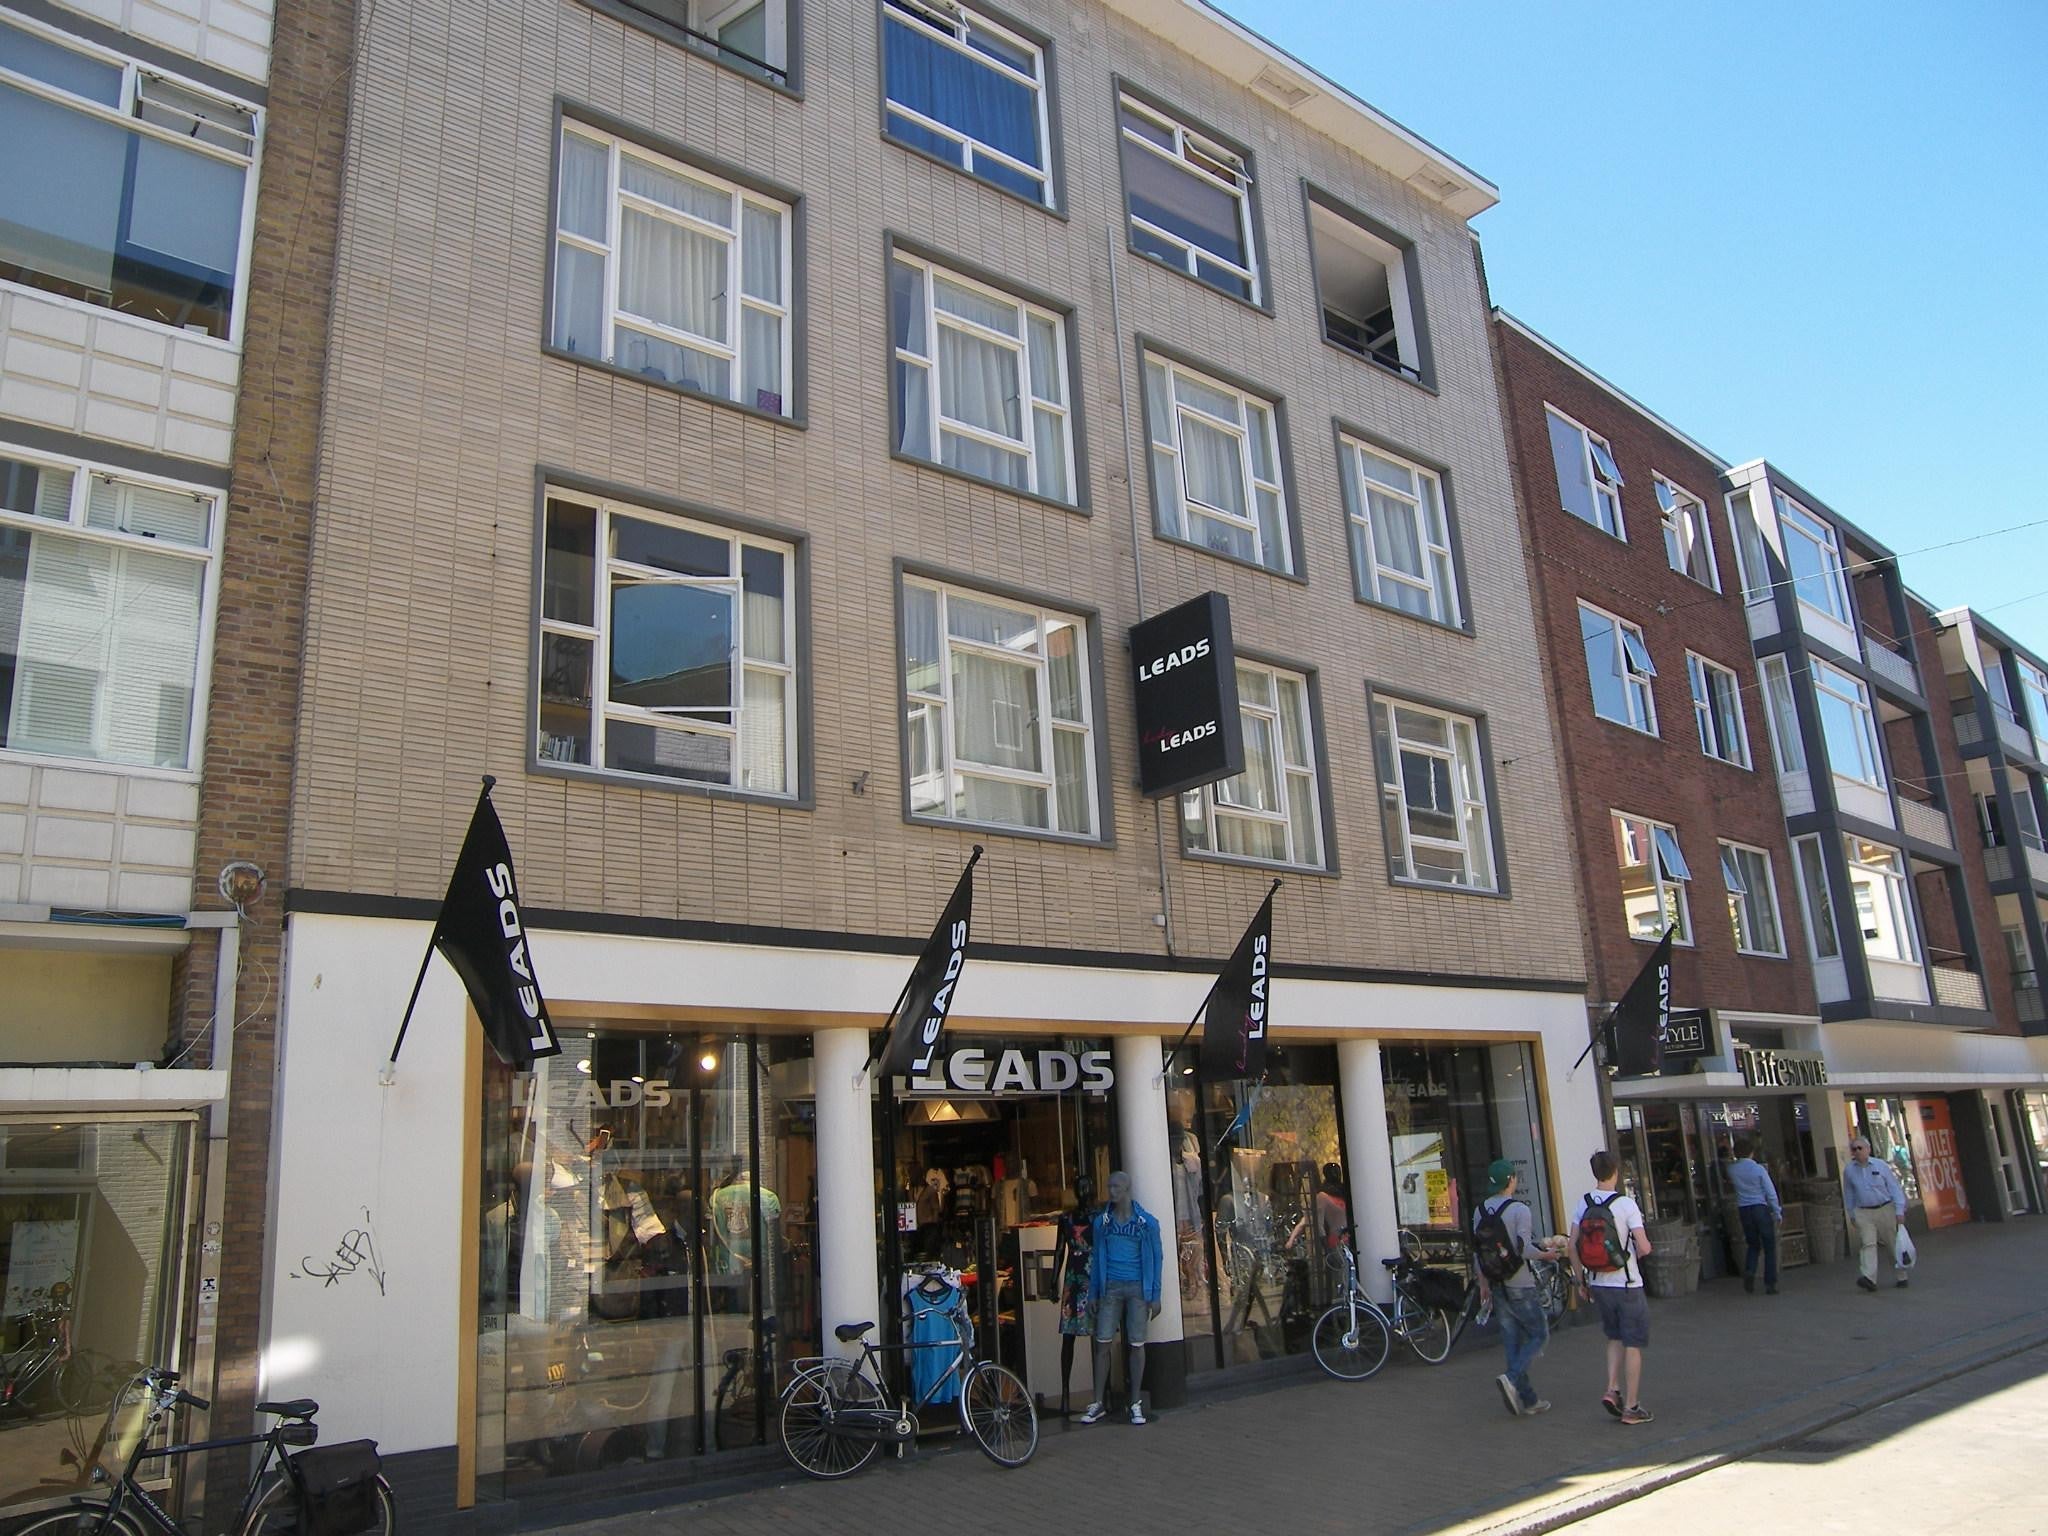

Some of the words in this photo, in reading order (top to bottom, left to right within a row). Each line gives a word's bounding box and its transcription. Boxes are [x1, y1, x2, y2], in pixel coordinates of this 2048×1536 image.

[1139, 637, 1210, 682] LEADS
[1160, 720, 1217, 752] LEADS
[485, 862, 553, 1051] LEADS
[911, 919, 967, 1071] LEADS
[1249, 934, 1267, 1039] LEADS
[1658, 963, 1670, 1041] LEADS
[511, 1072, 671, 1107] LEADS
[1914, 1128, 1953, 1160] OUTLET
[1918, 1156, 1959, 1192] STORE
